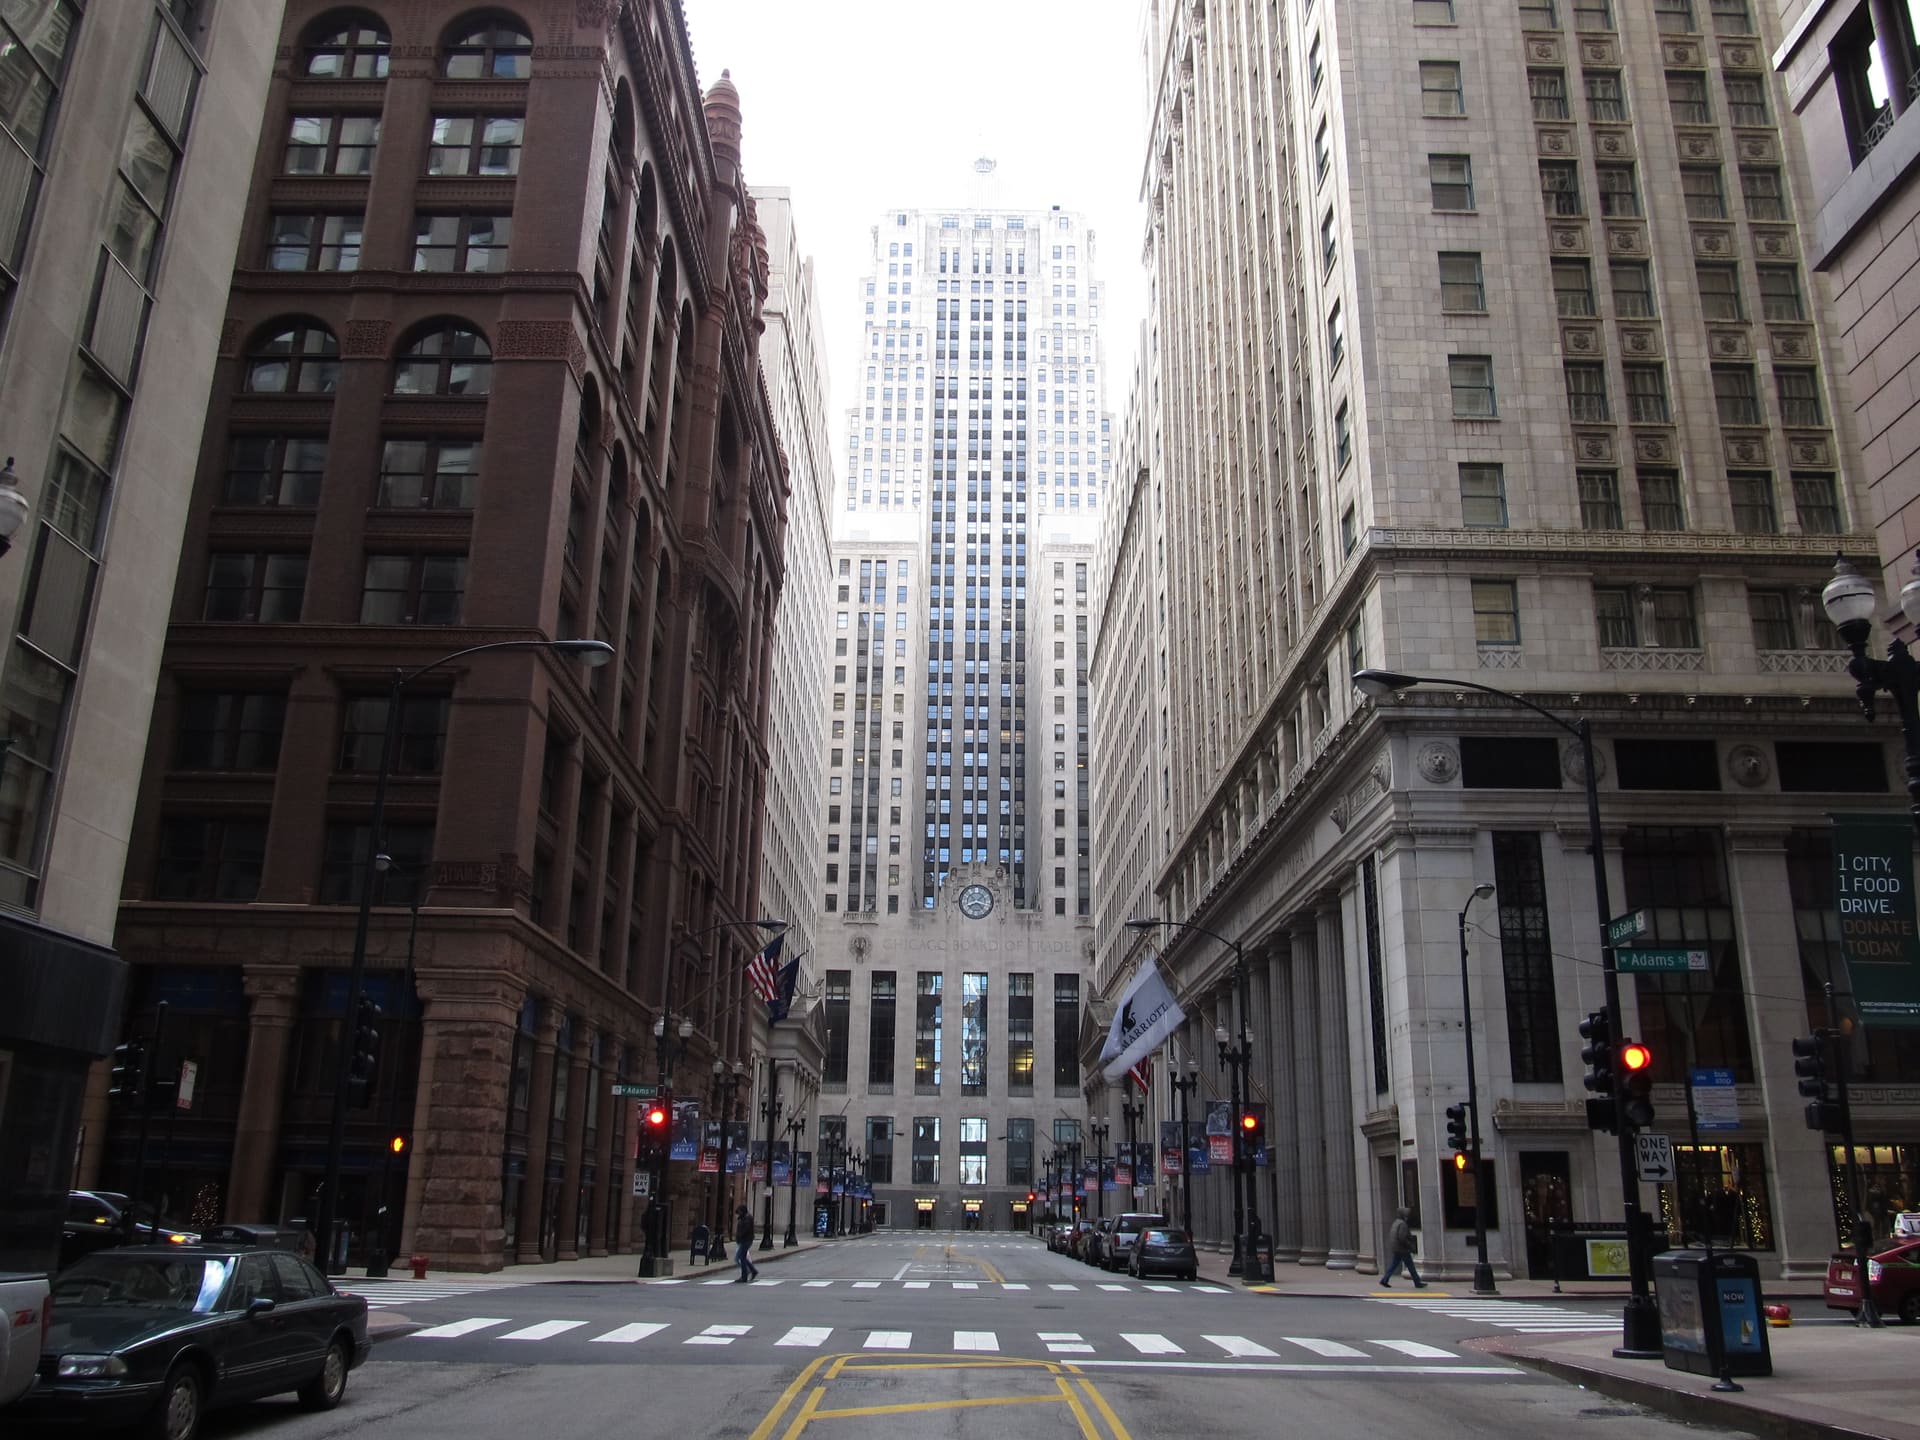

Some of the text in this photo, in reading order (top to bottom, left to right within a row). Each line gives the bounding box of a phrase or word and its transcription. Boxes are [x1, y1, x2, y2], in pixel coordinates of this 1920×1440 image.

[1838, 853, 1892, 873] 1 CITY,
[1839, 875, 1901, 893] 1 FOOD
[1840, 898, 1895, 914] DRIVE.
[1843, 919, 1913, 936] DONATE
[882, 938, 1072, 953] CHICAGO BOARD OF TRADE
[1631, 953, 1675, 967] Adams
[1120, 1002, 1169, 1055] MARRIOTT
[626, 1087, 650, 1095] Adams
[1640, 1137, 1667, 1149] ONE
[1640, 1150, 1668, 1163] WAY
